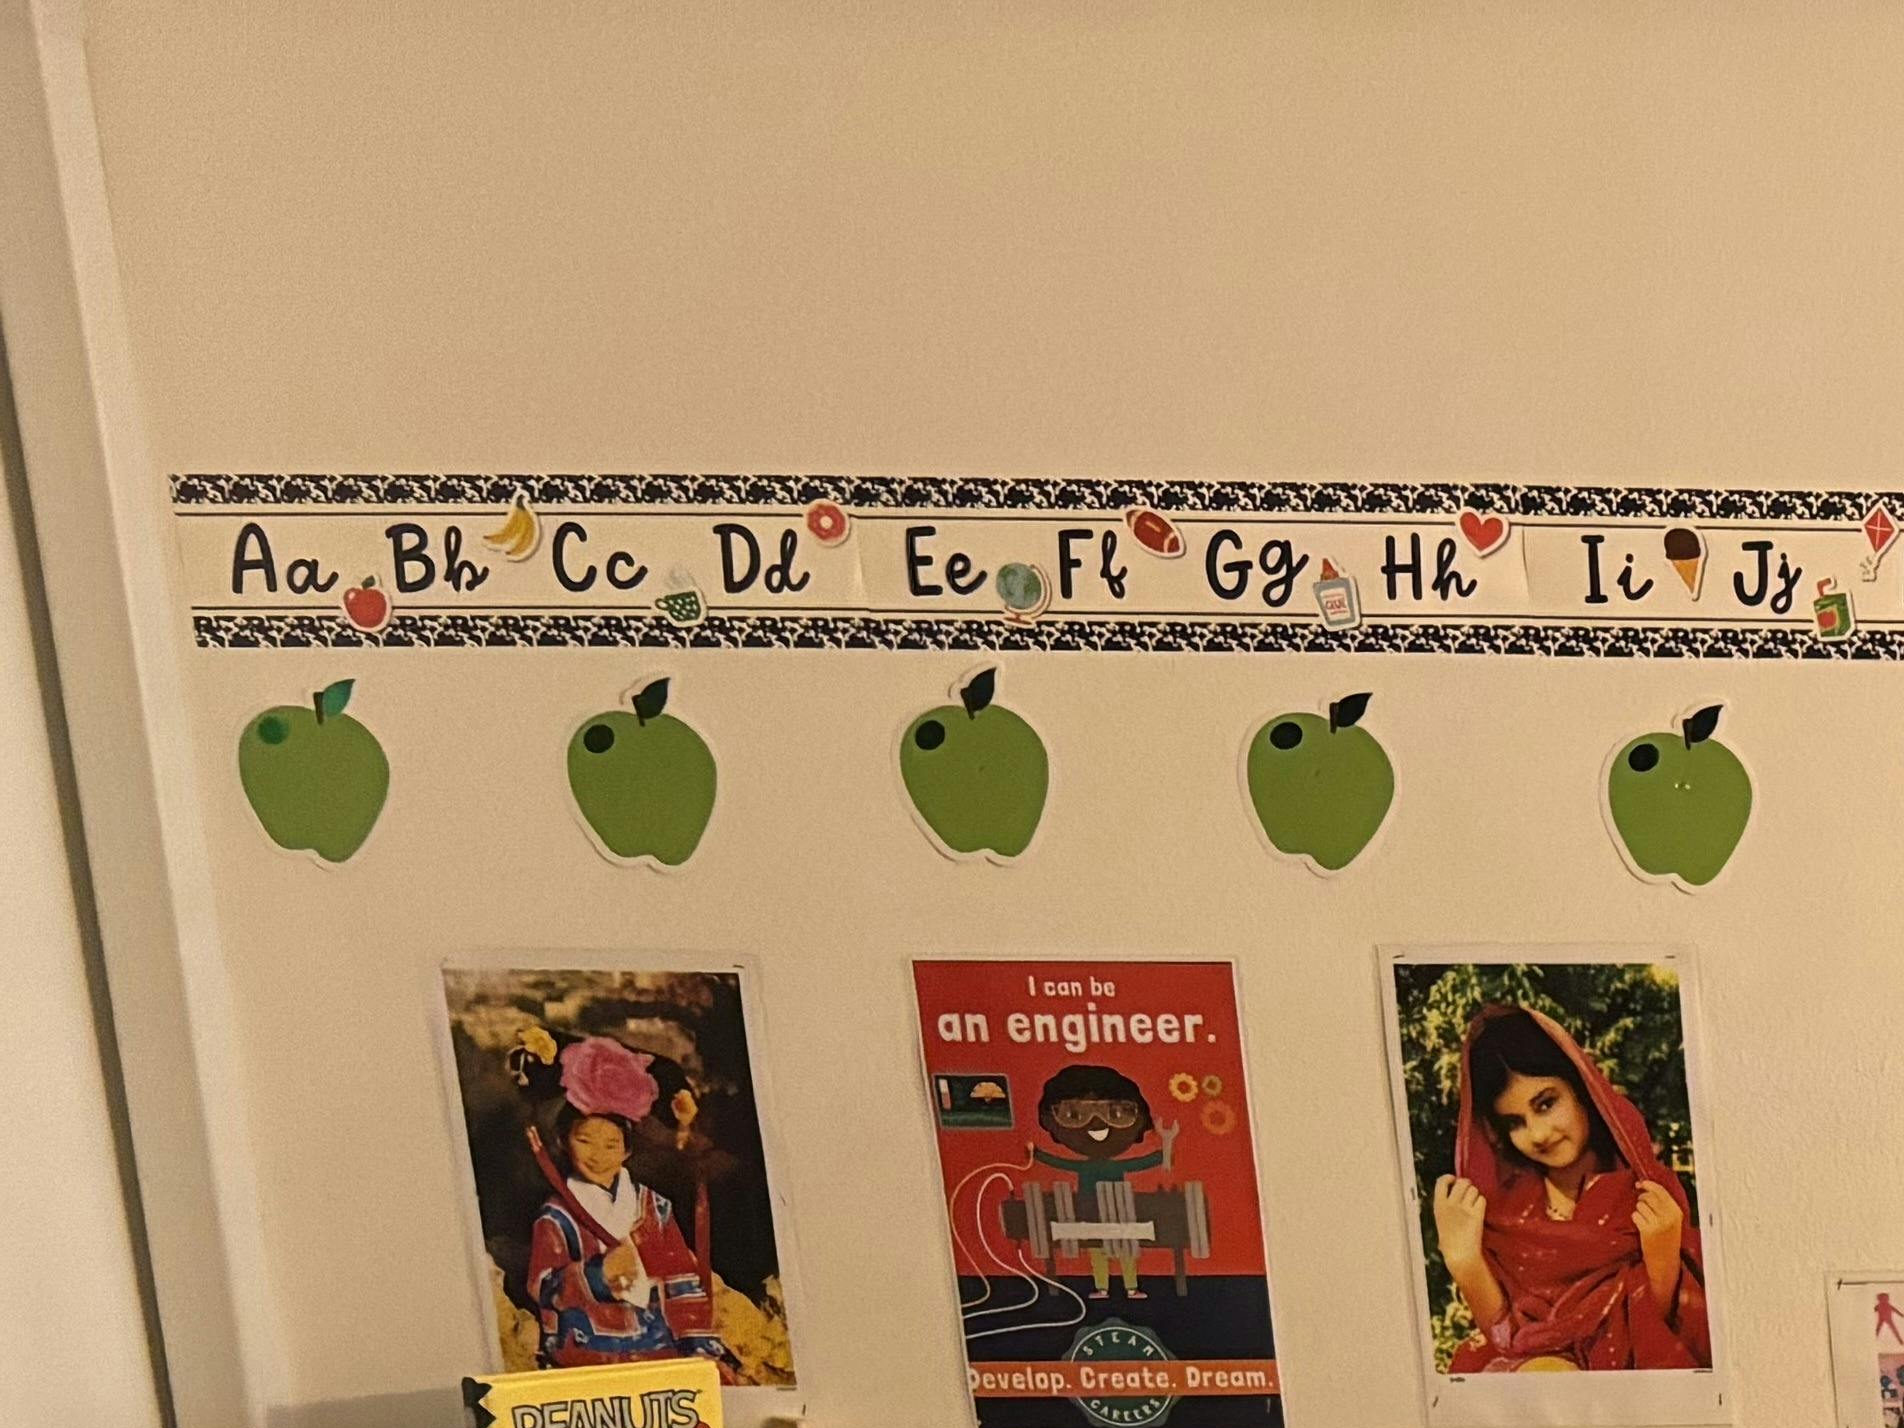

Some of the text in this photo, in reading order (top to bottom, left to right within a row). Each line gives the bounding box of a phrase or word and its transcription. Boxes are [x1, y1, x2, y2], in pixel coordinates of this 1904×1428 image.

[231, 523, 339, 596] Aa
[386, 527, 489, 592] Bb
[551, 523, 649, 589] Cc
[715, 524, 811, 592] Dd
[906, 527, 987, 596] Ee
[1057, 529, 1129, 600] Ff
[1205, 531, 1311, 607] Gg
[1382, 534, 1478, 600] Hh
[1581, 534, 1654, 604] Ii
[1732, 542, 1804, 617] Jj
[1028, 976, 1115, 998] I can be
[938, 1003, 1216, 1053] an engineer.
[1081, 1332, 1155, 1357] STEAM
[969, 1366, 1273, 1395] Develop. Create. Dream.
[1090, 1398, 1162, 1423] CAREERS
